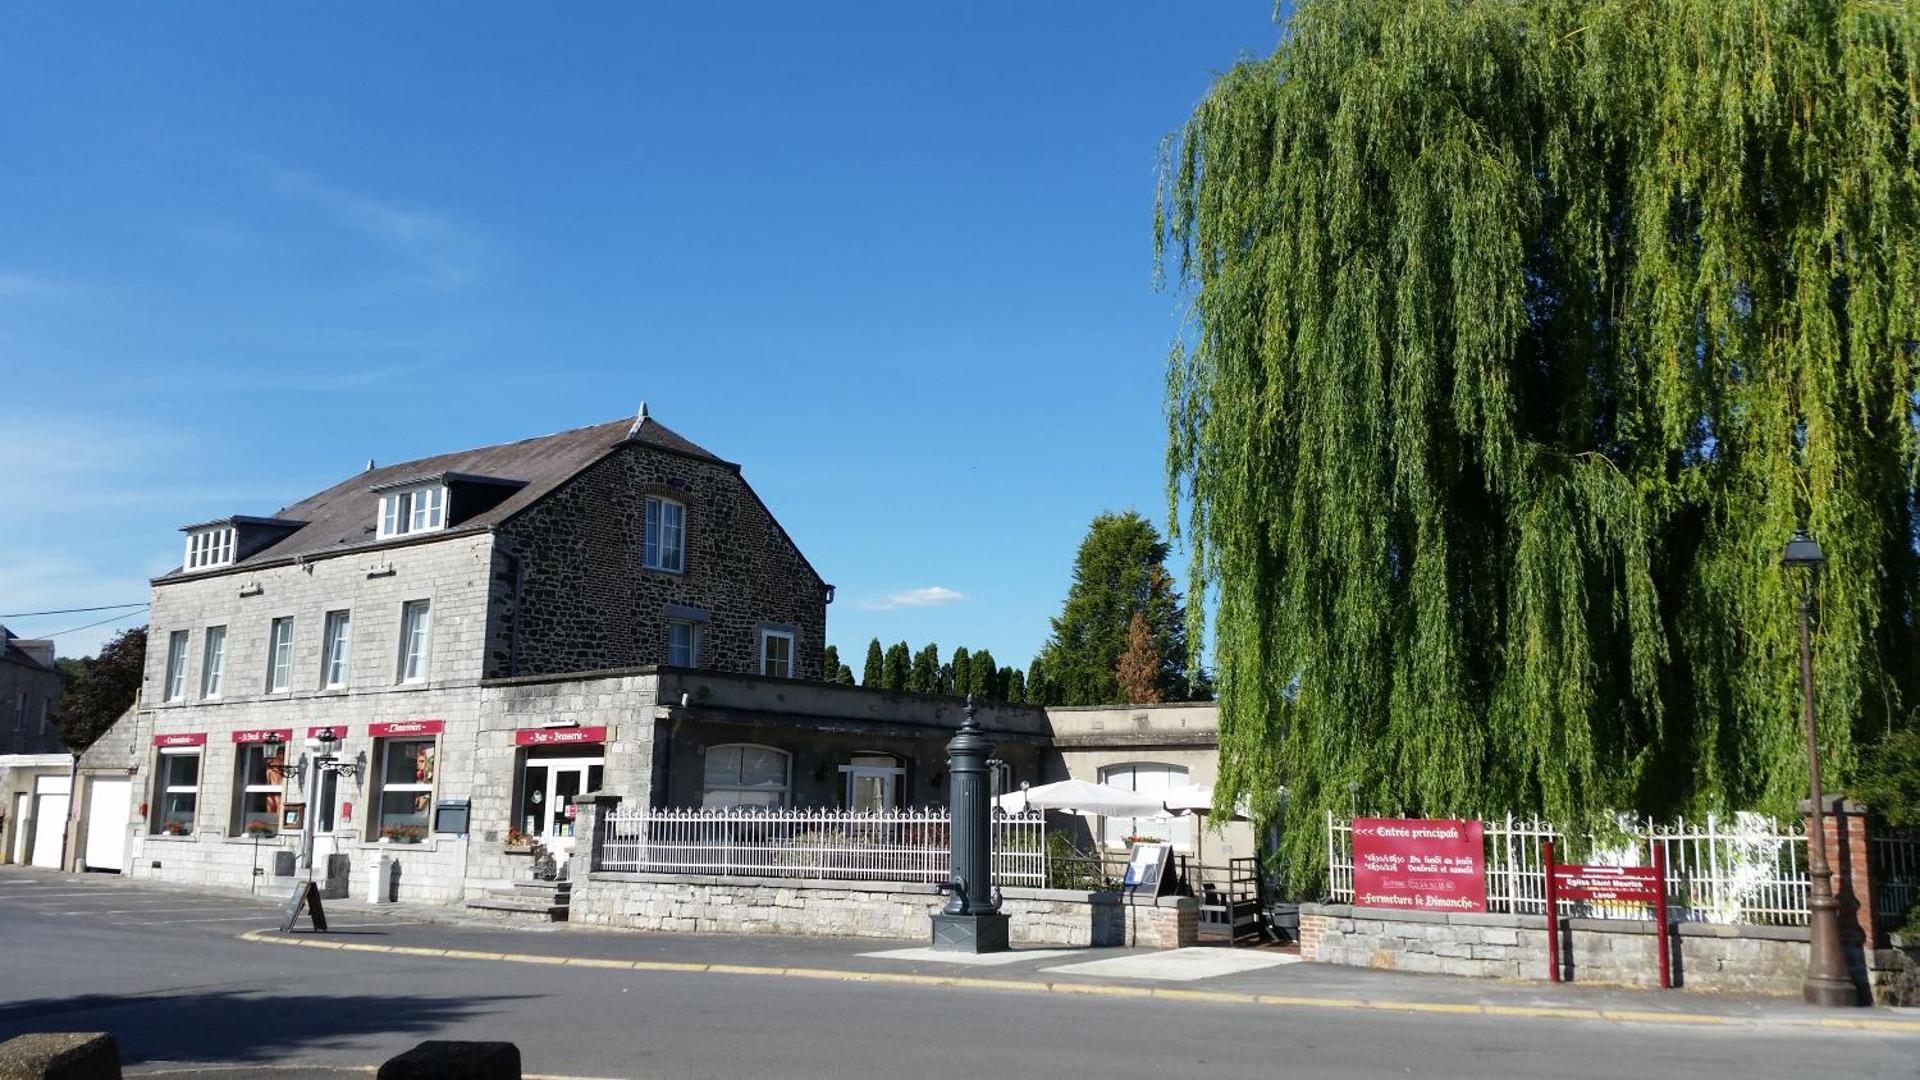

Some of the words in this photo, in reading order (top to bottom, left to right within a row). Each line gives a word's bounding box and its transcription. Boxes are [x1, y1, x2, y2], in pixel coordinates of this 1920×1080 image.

[1377, 826, 1410, 837] Entrée
[1411, 827, 1458, 839] principale
[1409, 855, 1421, 864] Du
[1424, 855, 1442, 864] lundi
[1455, 856, 1473, 866] jeudi
[1440, 865, 1448, 873] et
[1612, 879, 1643, 887] Maurice
[1415, 894, 1423, 905] le
[1425, 895, 1473, 909] Dimanche
